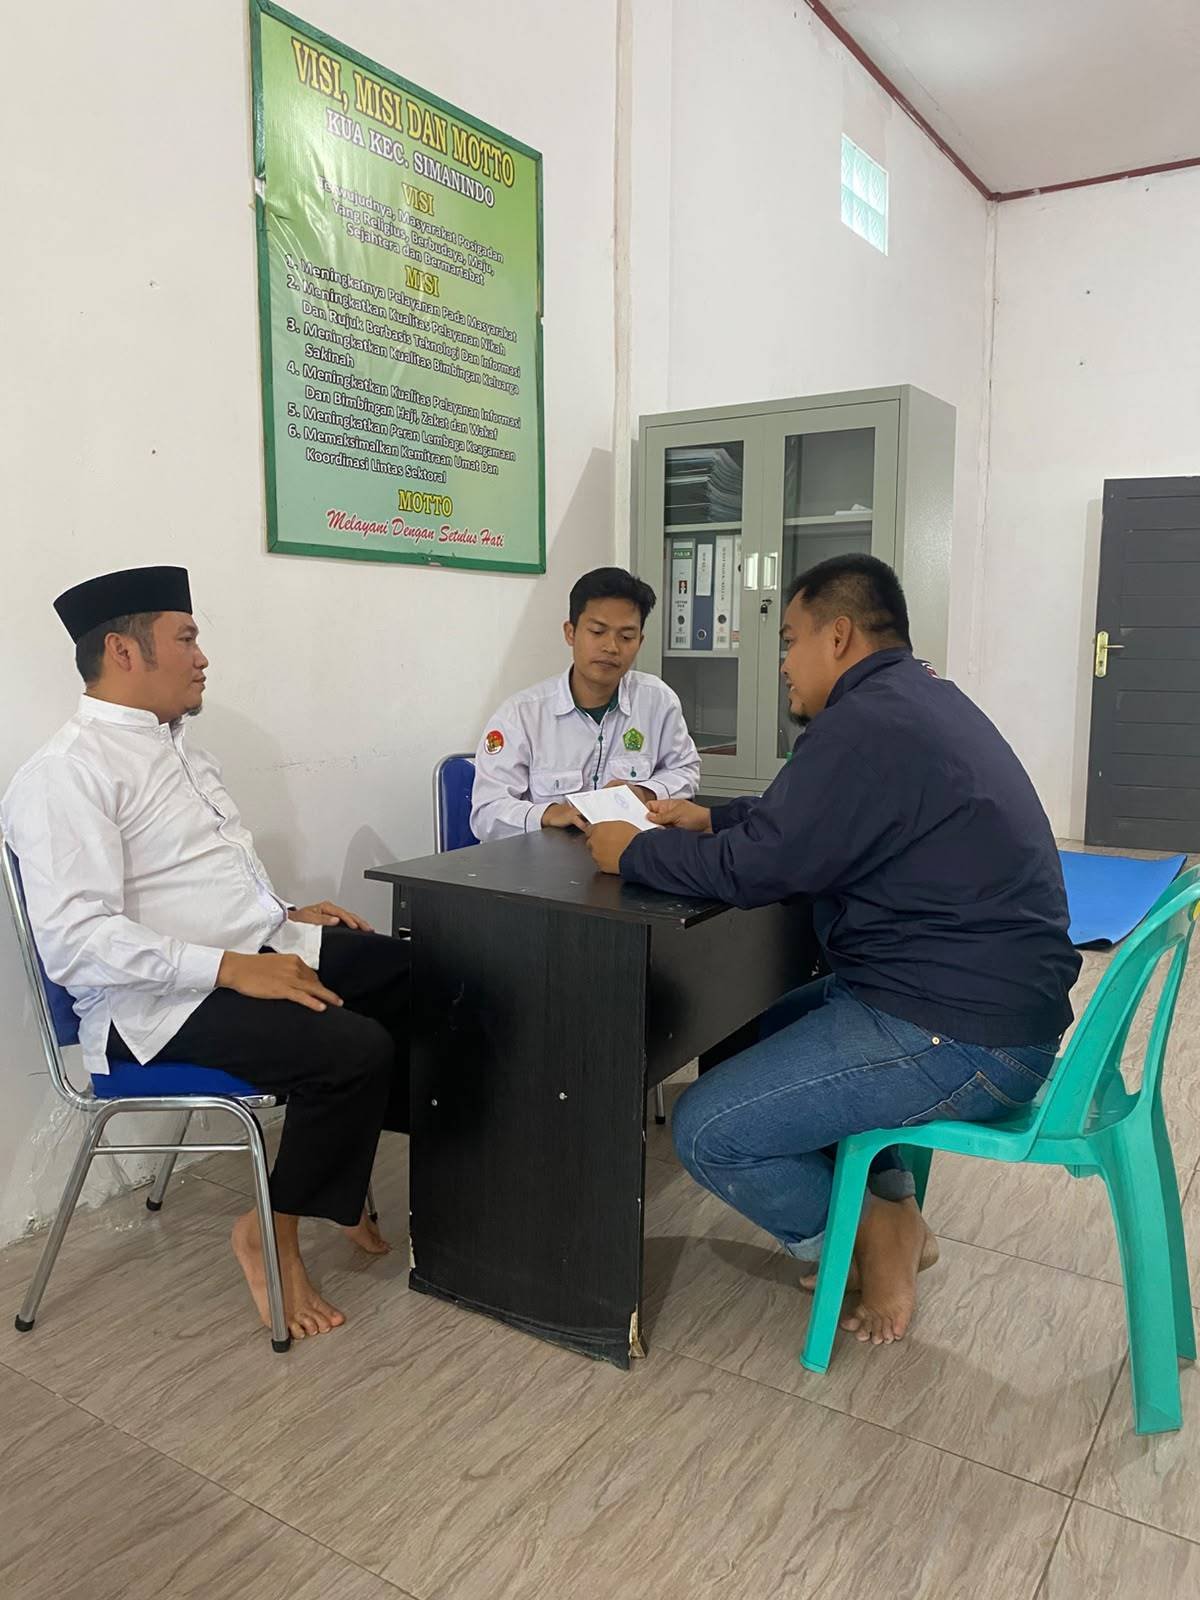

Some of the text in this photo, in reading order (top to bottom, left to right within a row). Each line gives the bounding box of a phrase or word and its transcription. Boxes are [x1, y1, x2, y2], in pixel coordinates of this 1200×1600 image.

[291, 37, 515, 187] VISI, MISI DAN MOTTO
[326, 109, 495, 208] KUA KEC. SIMANINDO
[402, 182, 434, 216] VISI
[333, 199, 494, 277] Yang Religius, Berbudaya, Maju,
[347, 223, 485, 286] Sejahtera dan Bermartabat
[398, 209, 457, 244] Masyarakat
[458, 234, 504, 264] Posigadan
[286, 254, 517, 343] 1. Meningkatnya Pelayanan Pada Masyarakat
[405, 265, 440, 297] MISI
[287, 274, 506, 356] 2. Meningkatkan Kualitas Pelayanan Nikah
[303, 300, 521, 378] Dan Rujuk Berbasis Teknologi Dan Informasi
[287, 318, 519, 396] 3. Meningkatkan Kualitas Bimbingan Keluarga
[305, 344, 355, 368] Sakinah
[287, 361, 521, 429] 4. Meningkatkan Kualitas Pelayanan Informasi
[305, 385, 498, 440] Dan Bimbingan Haji, Zakat dan Wakaf
[288, 402, 516, 461] 5. Meningkatkan Peran Lembaga Keagamaan
[288, 423, 499, 475] 6. Memaksimalkan Kemitraan Umat Dan
[306, 447, 447, 483] Koordinasi Lintas Sektoral
[326, 509, 504, 547] Melayani Dengan Setulus Hati
[399, 489, 453, 518] MOTTO
